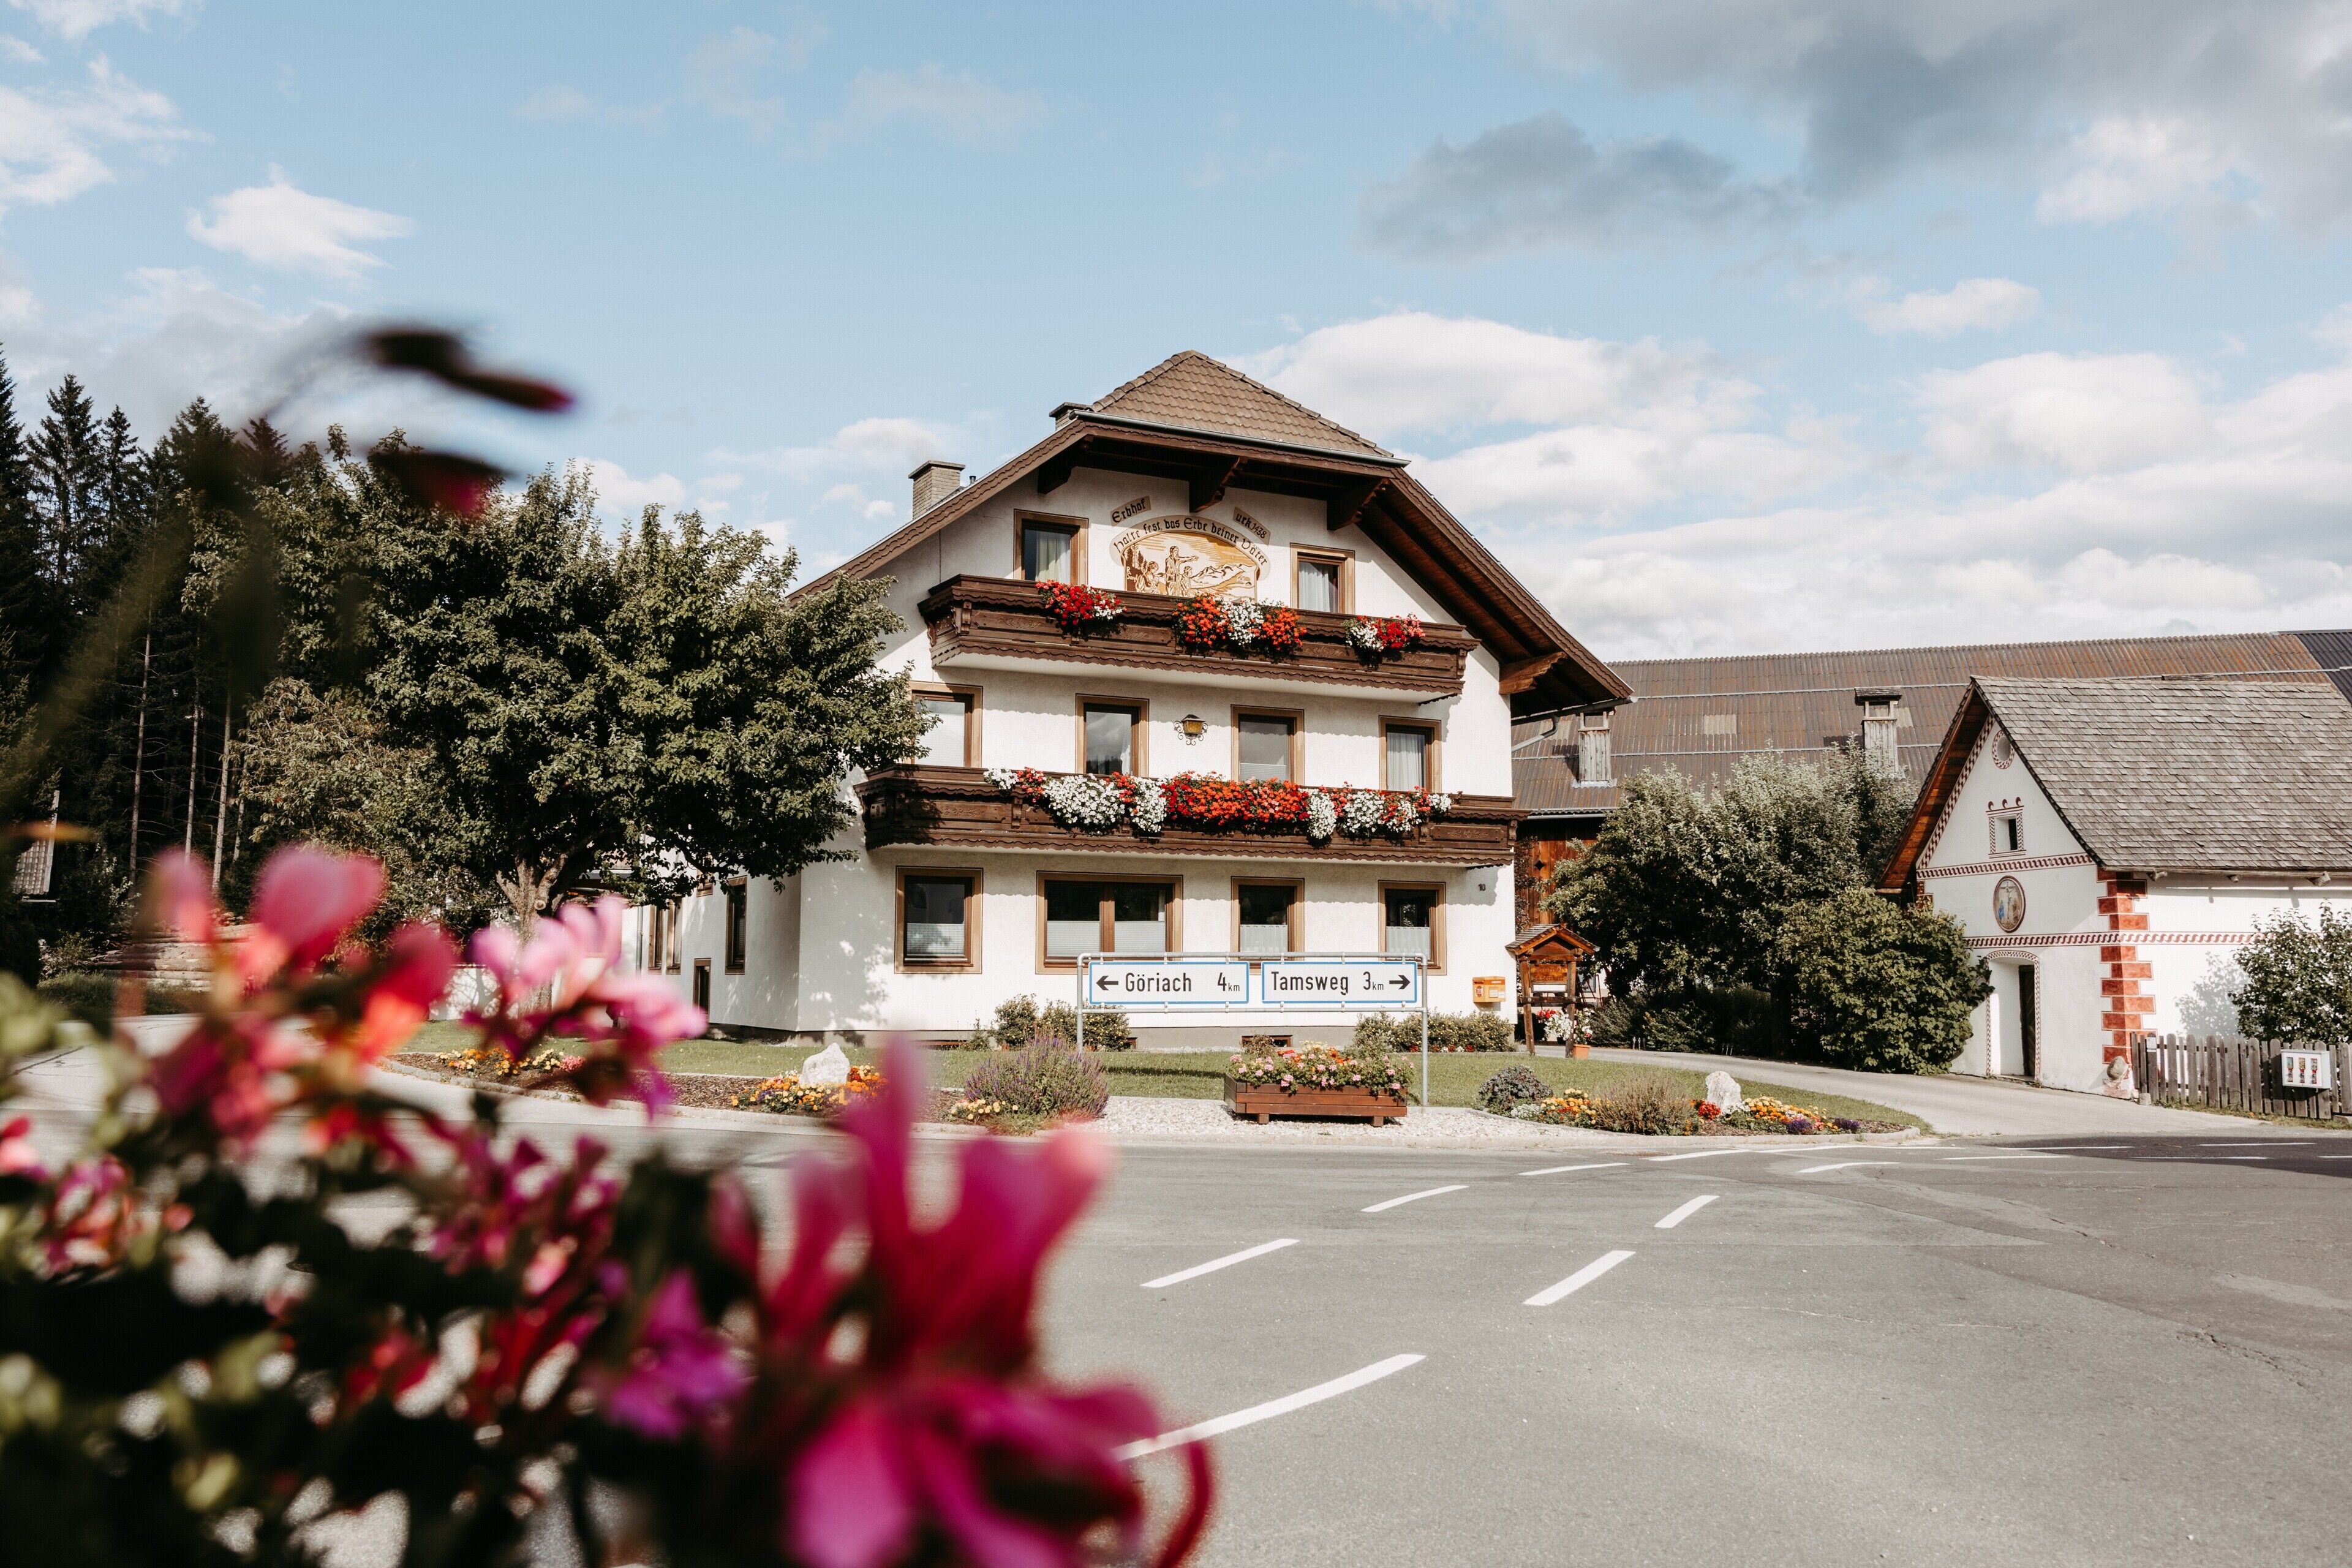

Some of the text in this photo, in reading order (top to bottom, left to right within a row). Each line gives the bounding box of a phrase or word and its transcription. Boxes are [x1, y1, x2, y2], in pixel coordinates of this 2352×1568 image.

[1112, 498, 1145, 523] Erbhof
[1164, 519, 1180, 529] das
[1183, 518, 1208, 530] Erbe
[1211, 522, 1239, 543] deiner
[1241, 538, 1268, 565] Väter
[1125, 972, 1191, 992] Göriach
[1271, 971, 1348, 995] Tamsweg
